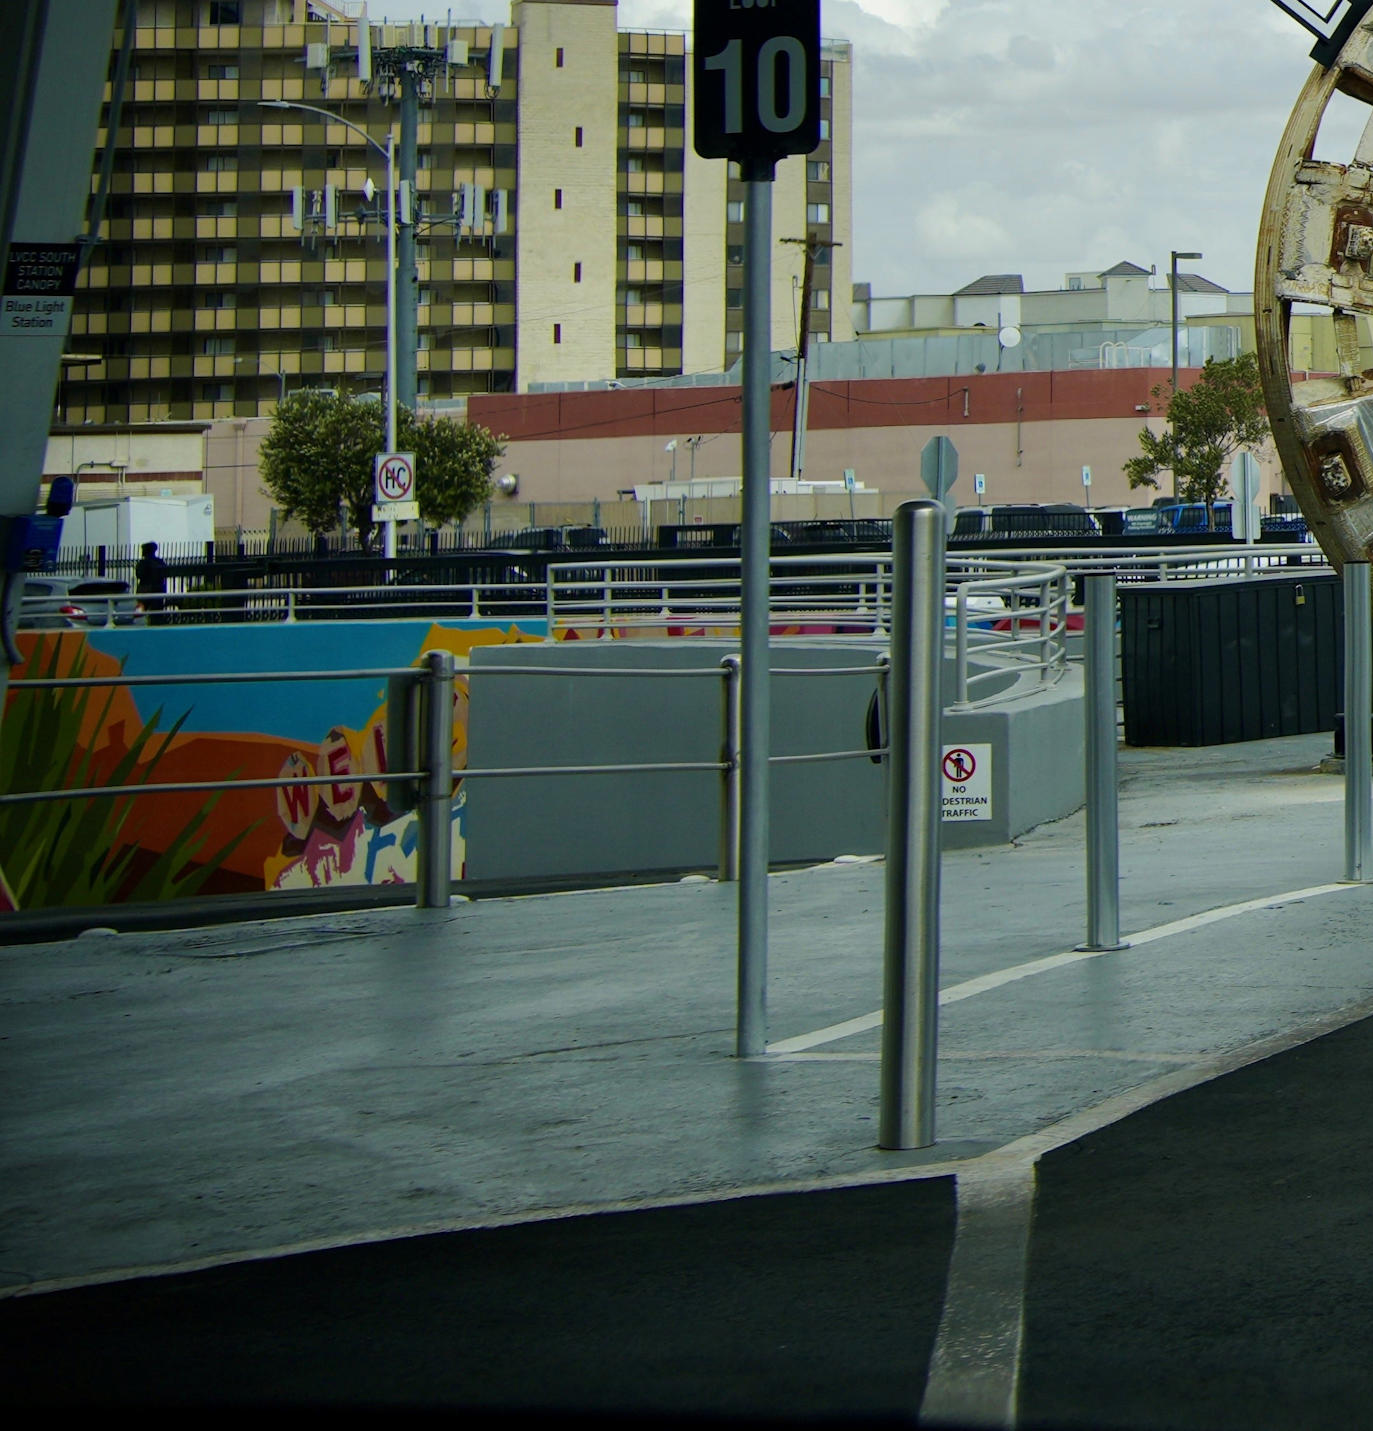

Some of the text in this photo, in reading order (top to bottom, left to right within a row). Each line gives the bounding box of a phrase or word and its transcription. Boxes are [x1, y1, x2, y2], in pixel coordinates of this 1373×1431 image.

[704, 35, 807, 134] 10
[9, 251, 76, 263] LVCC SOUTH
[17, 265, 64, 277] STATION
[17, 279, 62, 290] CANOPY
[5, 300, 65, 315] Blue Light
[11, 316, 53, 328] Station
[385, 467, 406, 489] HC
[952, 785, 967, 794] NO
[942, 797, 988, 806] DESTRIAN
